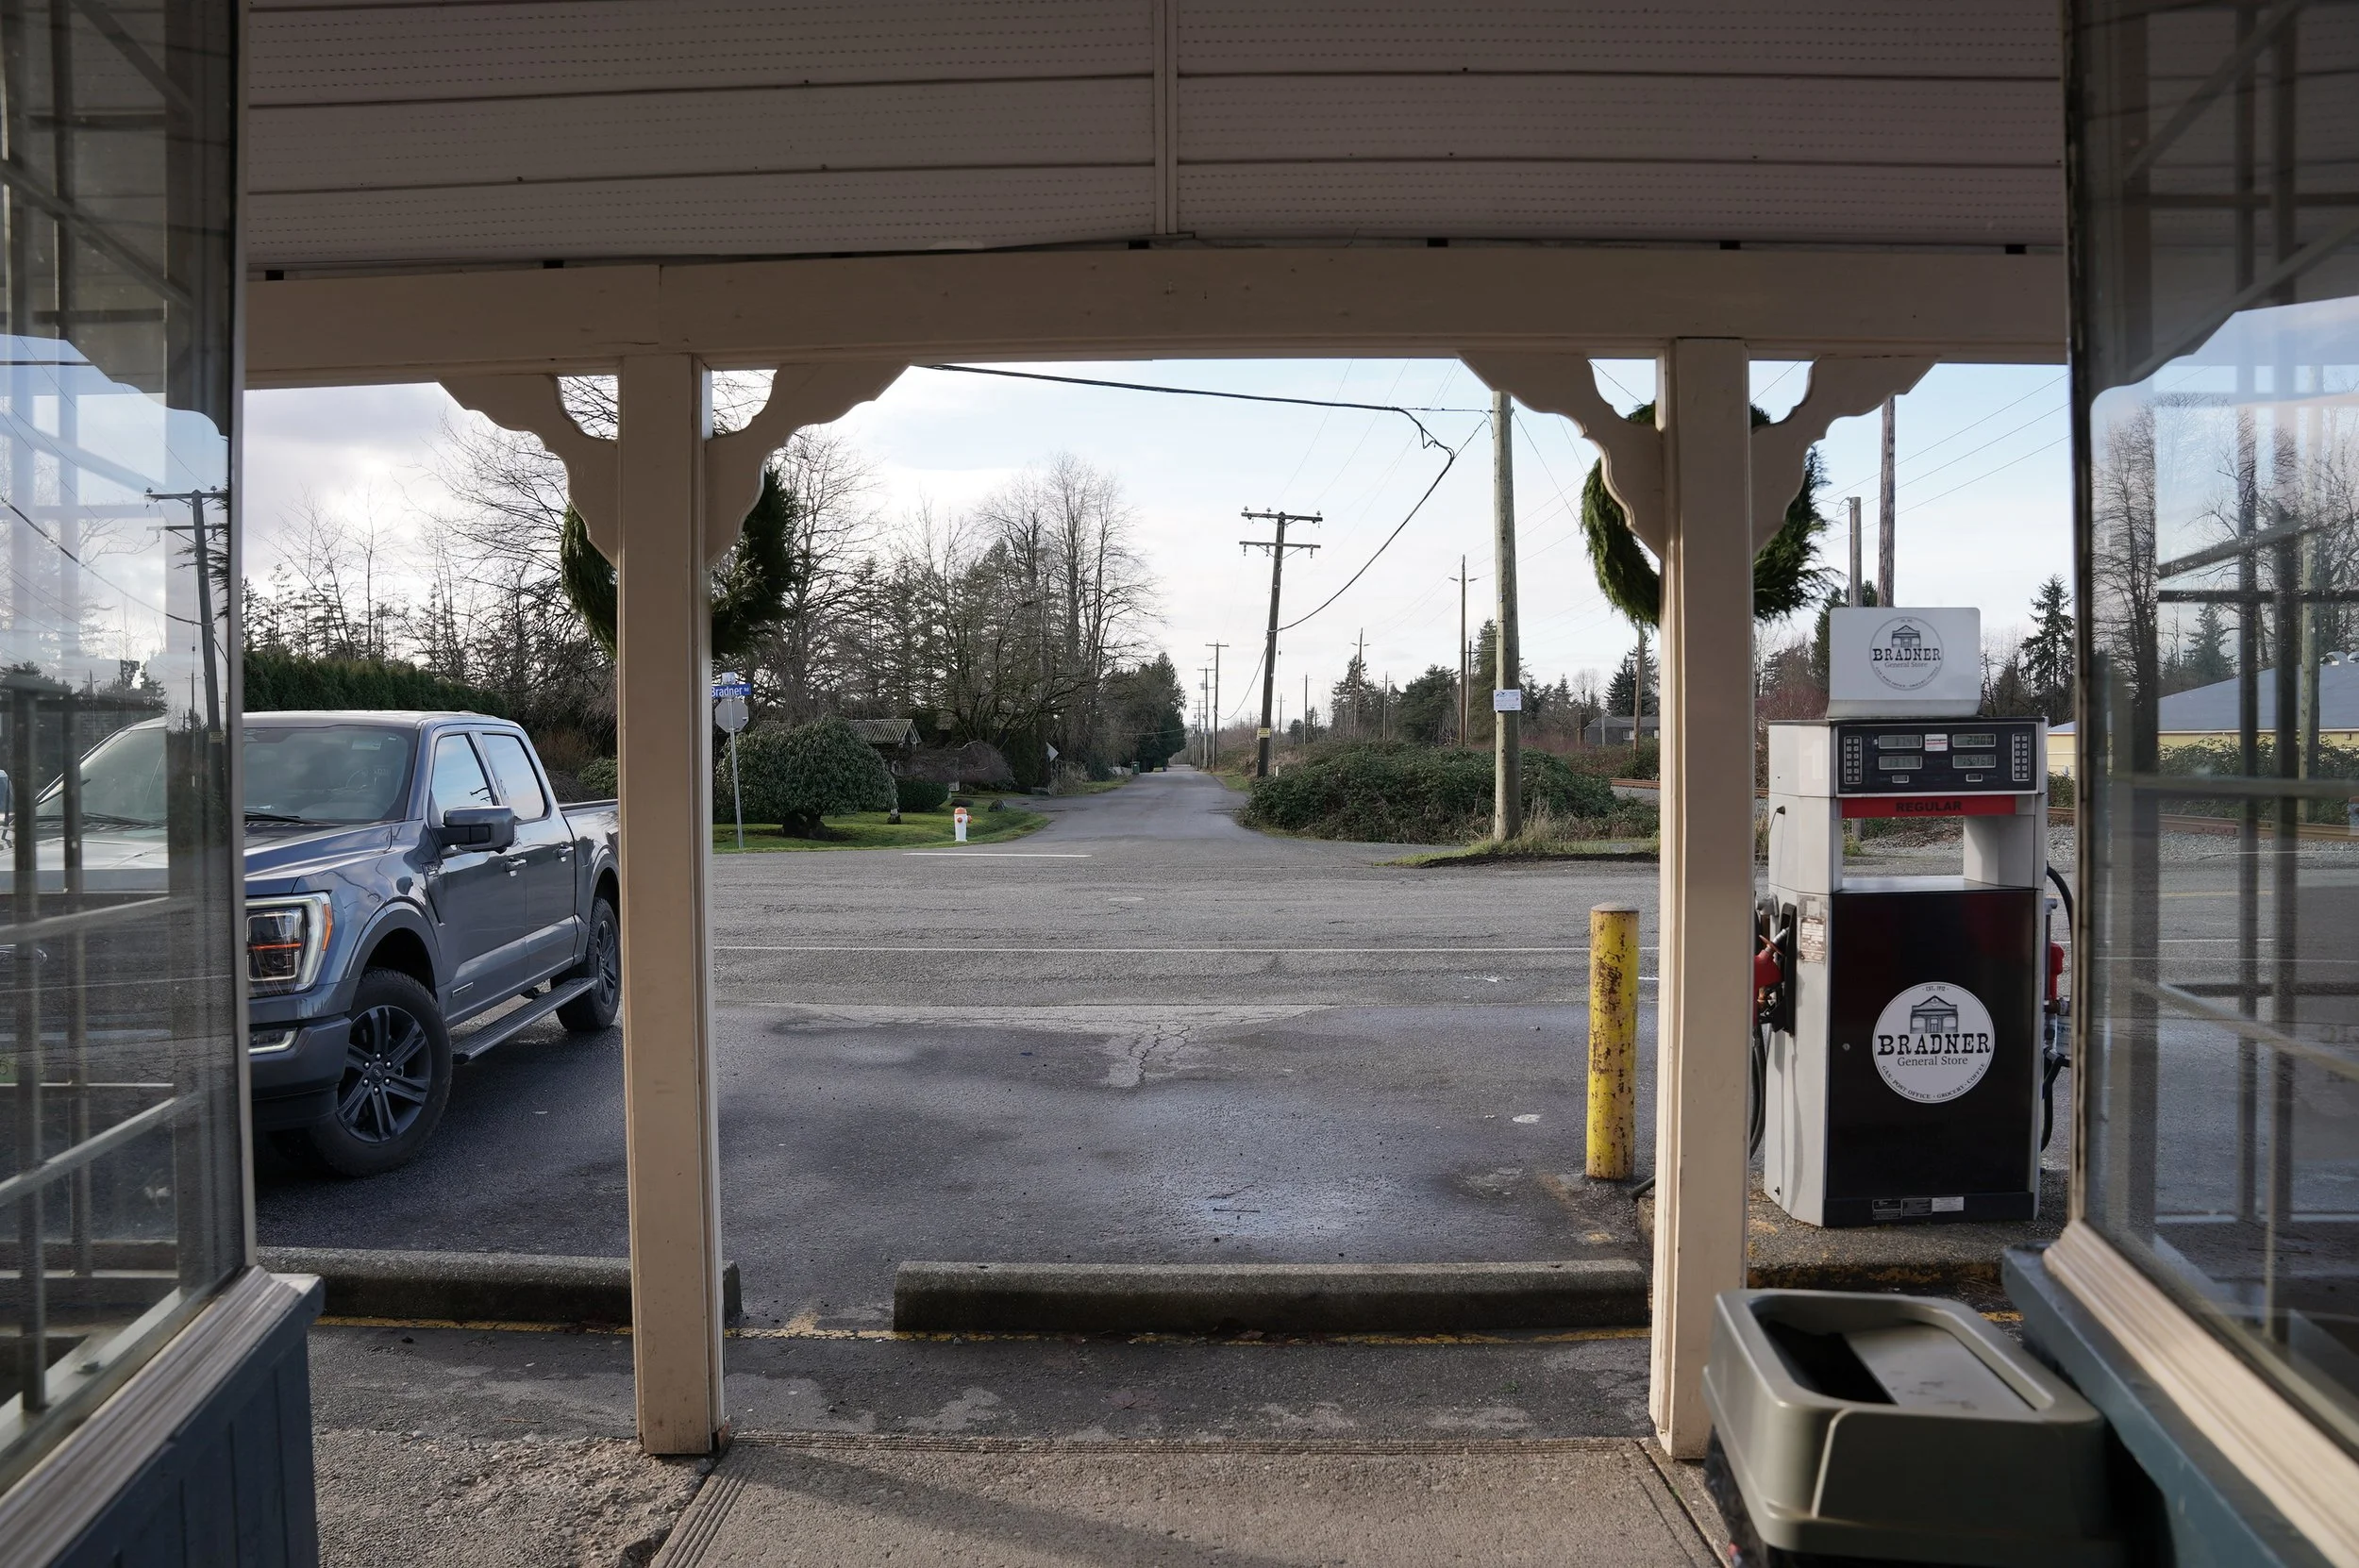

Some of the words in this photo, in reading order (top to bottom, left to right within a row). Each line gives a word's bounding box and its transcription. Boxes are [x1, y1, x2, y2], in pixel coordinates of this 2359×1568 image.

[1872, 648, 1941, 661] BRADNER
[711, 686, 743, 697] Bradner
[1896, 800, 1962, 811] REGULAR
[1878, 1033, 1990, 1056] BRADNER
[1897, 1056, 1937, 1066] General
[1941, 1056, 1968, 1065] Store
[1882, 1065, 1891, 1078] GAS
[1892, 1078, 1907, 1093] POST
[1907, 1089, 1931, 1099] OFFICE
[1936, 1085, 1965, 1099] GROCERY
[1966, 1063, 1985, 1084] COFFEE
